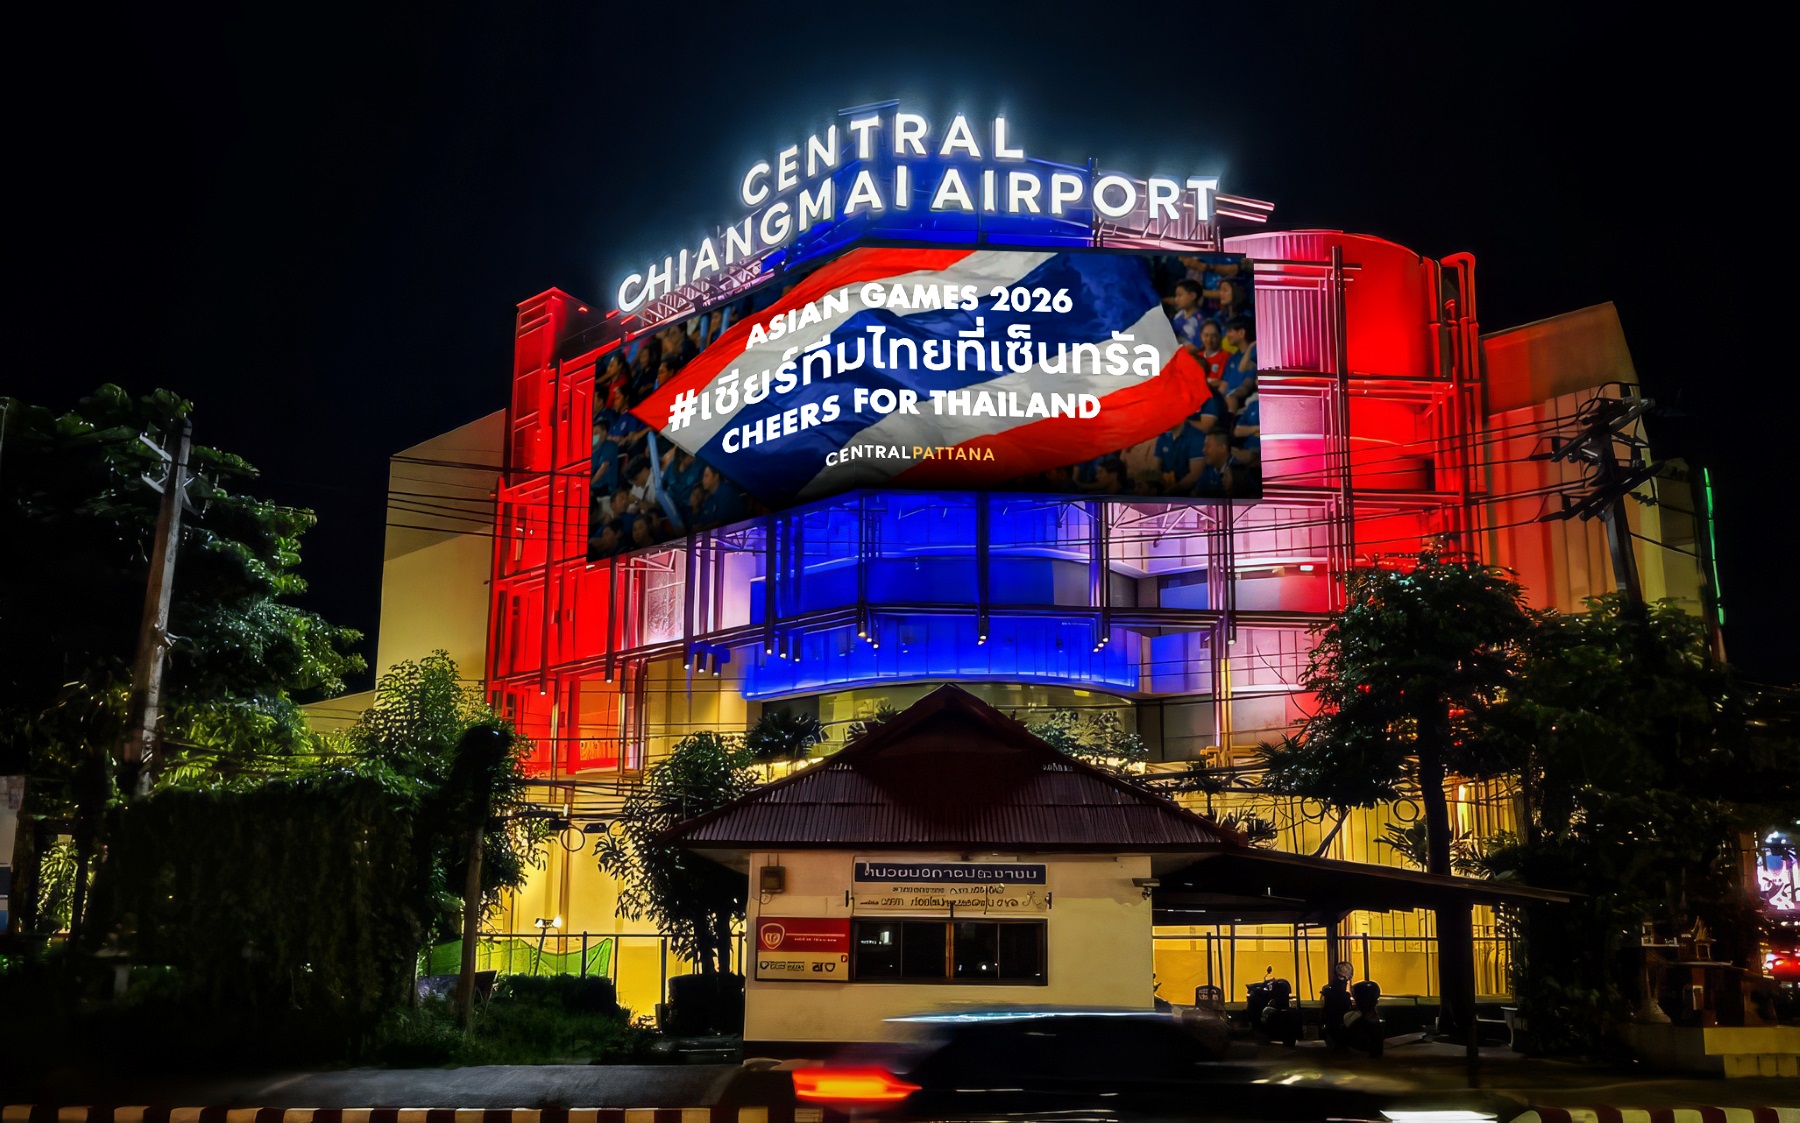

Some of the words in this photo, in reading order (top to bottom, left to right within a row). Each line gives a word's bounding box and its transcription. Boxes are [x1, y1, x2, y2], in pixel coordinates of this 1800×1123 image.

[742, 113, 1024, 206] CENTRAL
[617, 165, 907, 312] CHIANGMAI
[930, 168, 1218, 221] AIRPORT
[745, 287, 849, 350] ASIAN
[860, 283, 979, 312] GAMES
[990, 286, 1074, 313] 2026
[668, 316, 1160, 432] #เชียร์ทีมไทยที่เซ็นทรัล
[722, 395, 841, 454] CHEERS
[853, 388, 921, 415] FOR
[930, 390, 1101, 419] THAILAND
